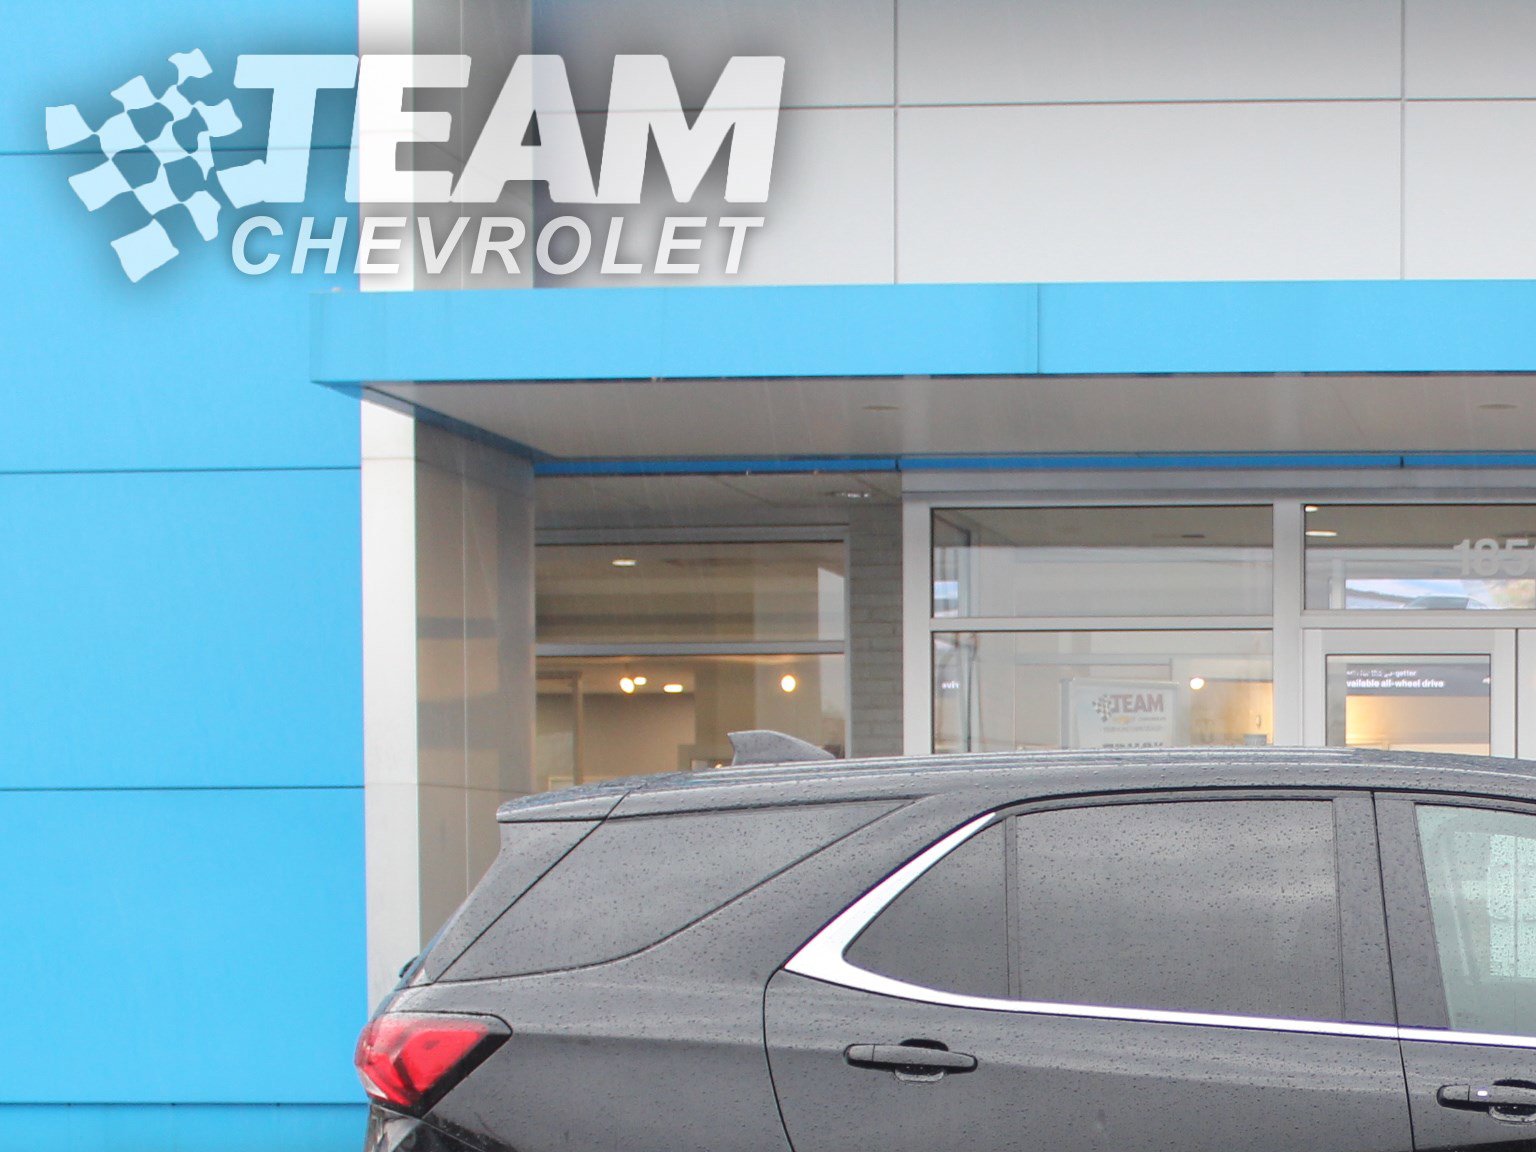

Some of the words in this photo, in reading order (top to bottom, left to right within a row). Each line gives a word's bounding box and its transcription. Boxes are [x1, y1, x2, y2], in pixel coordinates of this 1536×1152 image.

[1381, 678, 1421, 688] all-wheel
[1422, 678, 1445, 688] drive
[1111, 694, 1164, 713] TEAM
